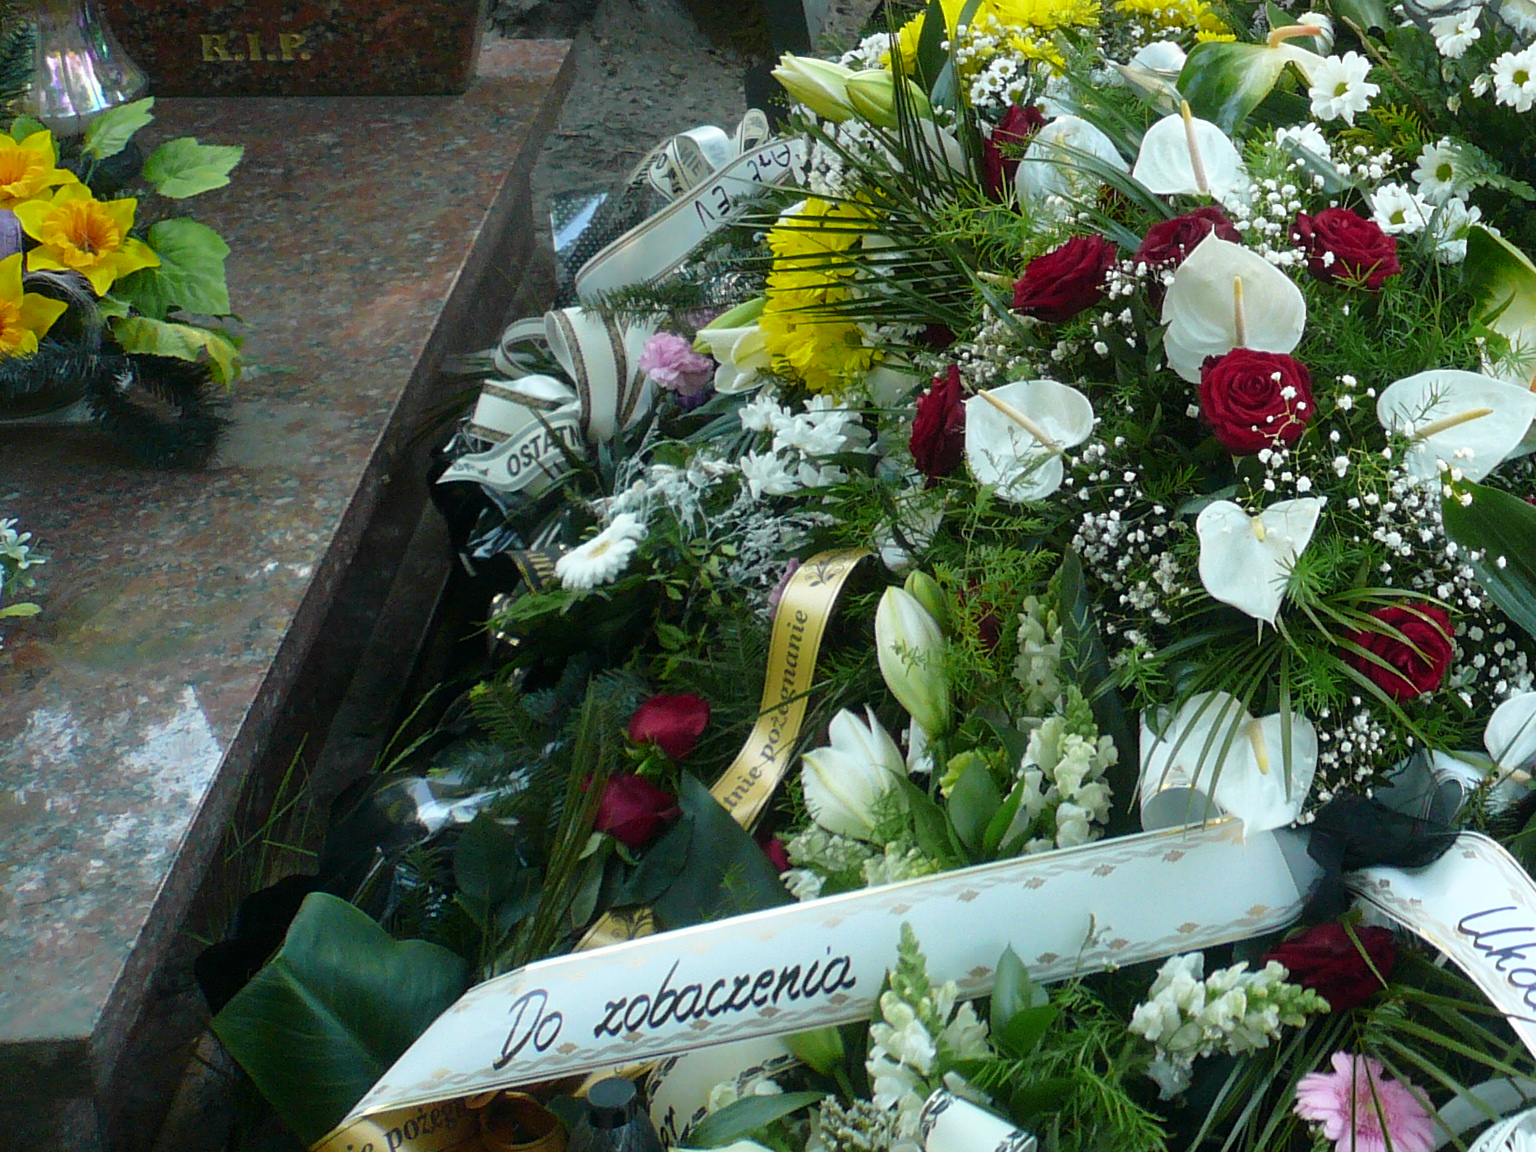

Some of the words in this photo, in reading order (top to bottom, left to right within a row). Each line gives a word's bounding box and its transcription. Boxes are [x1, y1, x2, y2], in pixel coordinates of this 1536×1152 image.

[199, 33, 312, 62] R.I.P.
[492, 988, 563, 1071] Do
[593, 945, 857, 1039] zobaczenia
